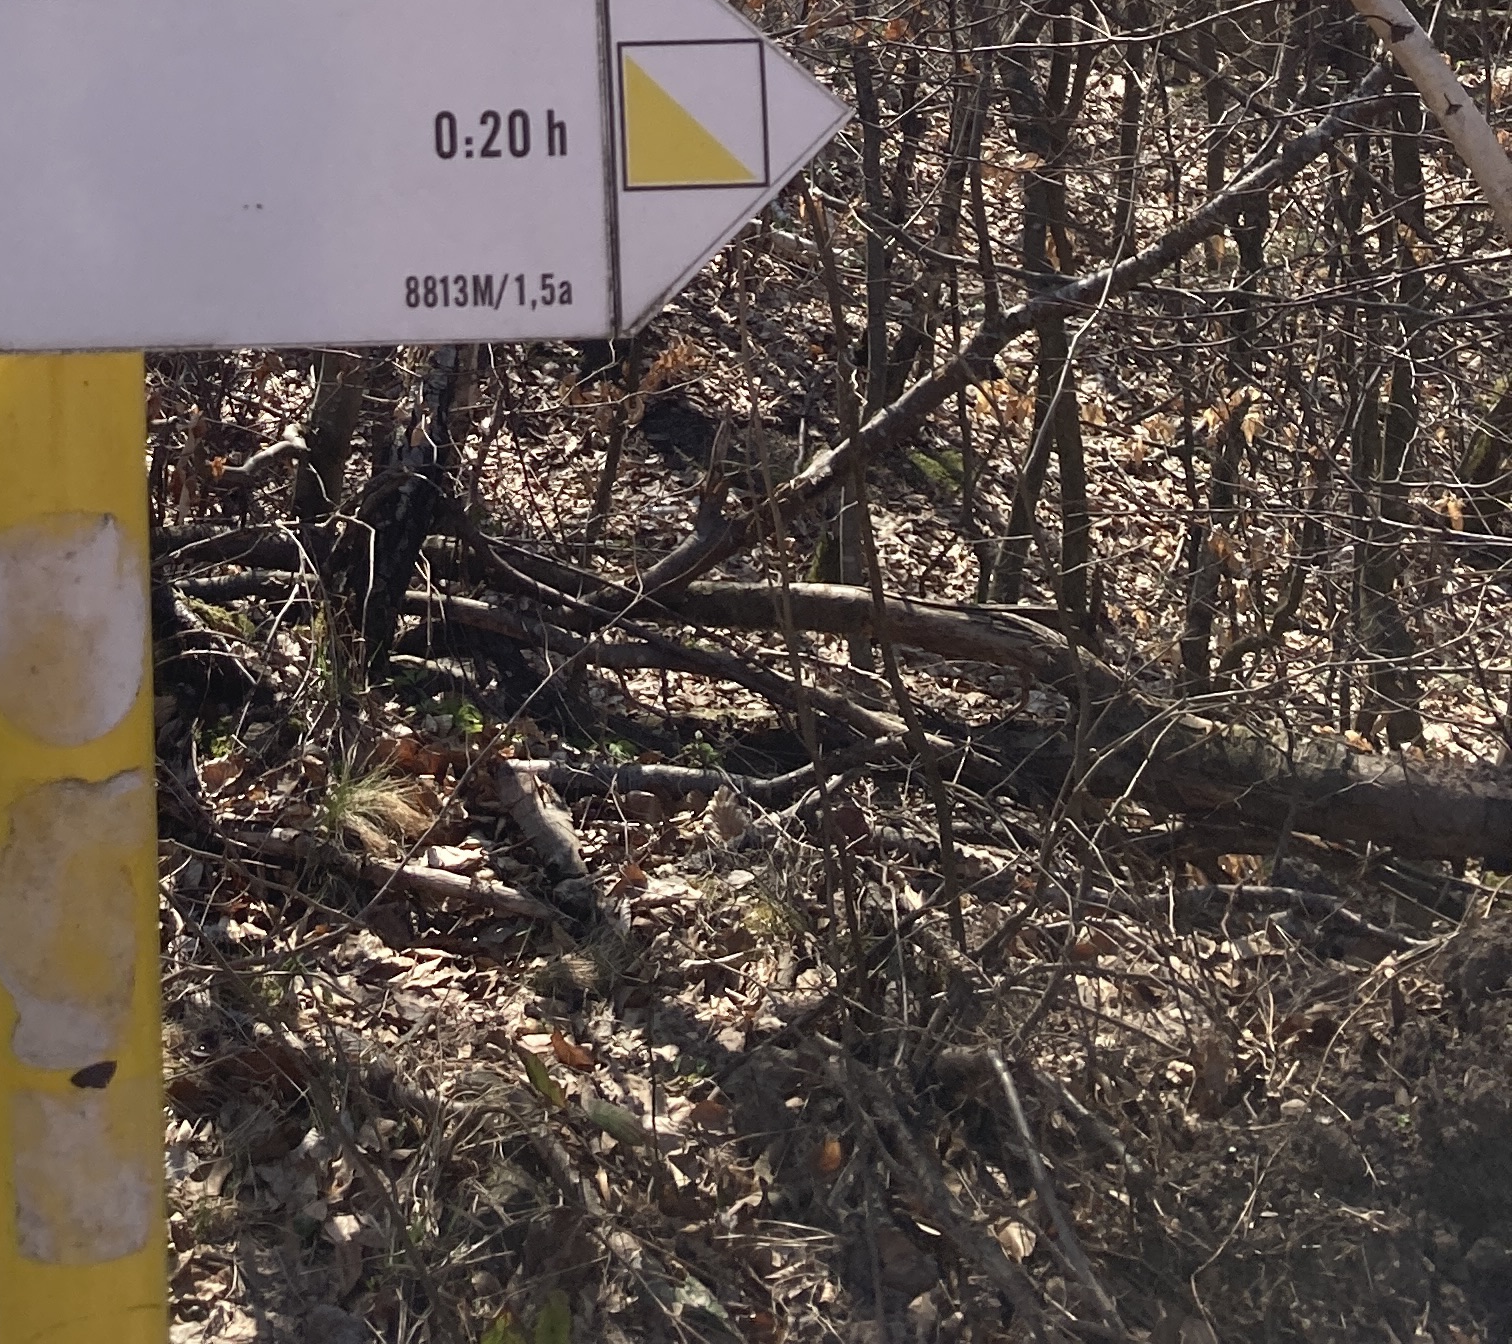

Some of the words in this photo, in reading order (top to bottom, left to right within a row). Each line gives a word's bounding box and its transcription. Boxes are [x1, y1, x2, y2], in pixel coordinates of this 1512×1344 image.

[433, 108, 531, 161] 0:20
[545, 108, 568, 158] h
[404, 272, 573, 311] 8813M/1,5a
